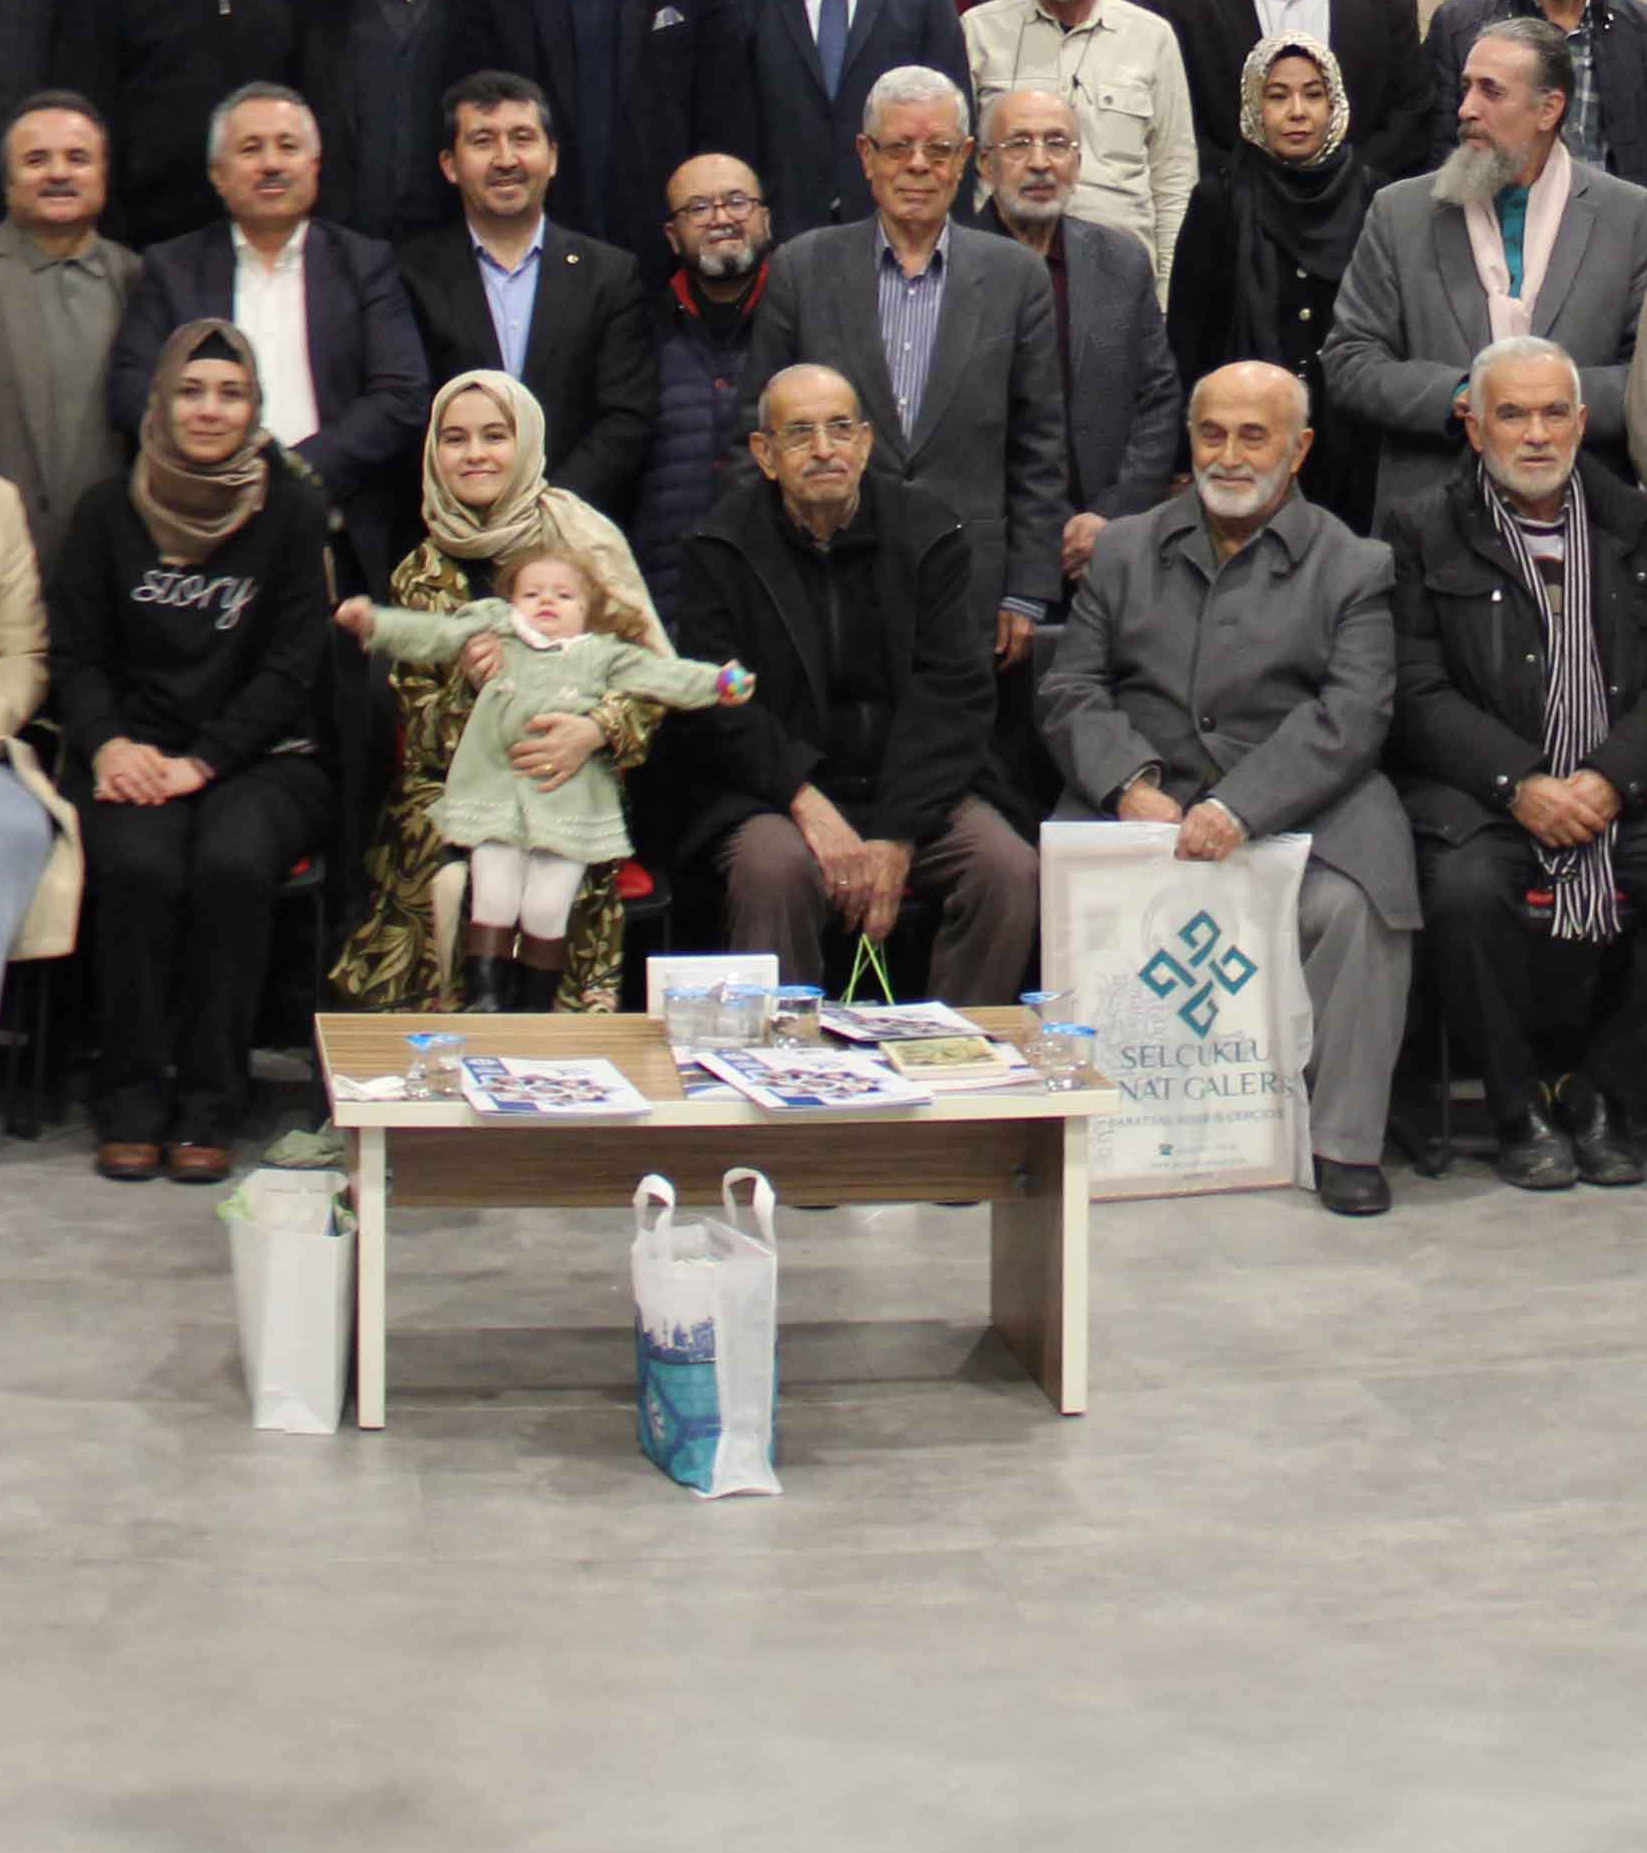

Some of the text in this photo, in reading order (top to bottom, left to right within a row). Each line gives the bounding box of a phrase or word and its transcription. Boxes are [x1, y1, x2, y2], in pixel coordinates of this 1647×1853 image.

[131, 568, 259, 630] story
[1119, 1040, 1270, 1074] SELÇUKLU
[1117, 1075, 1177, 1101] NAT
